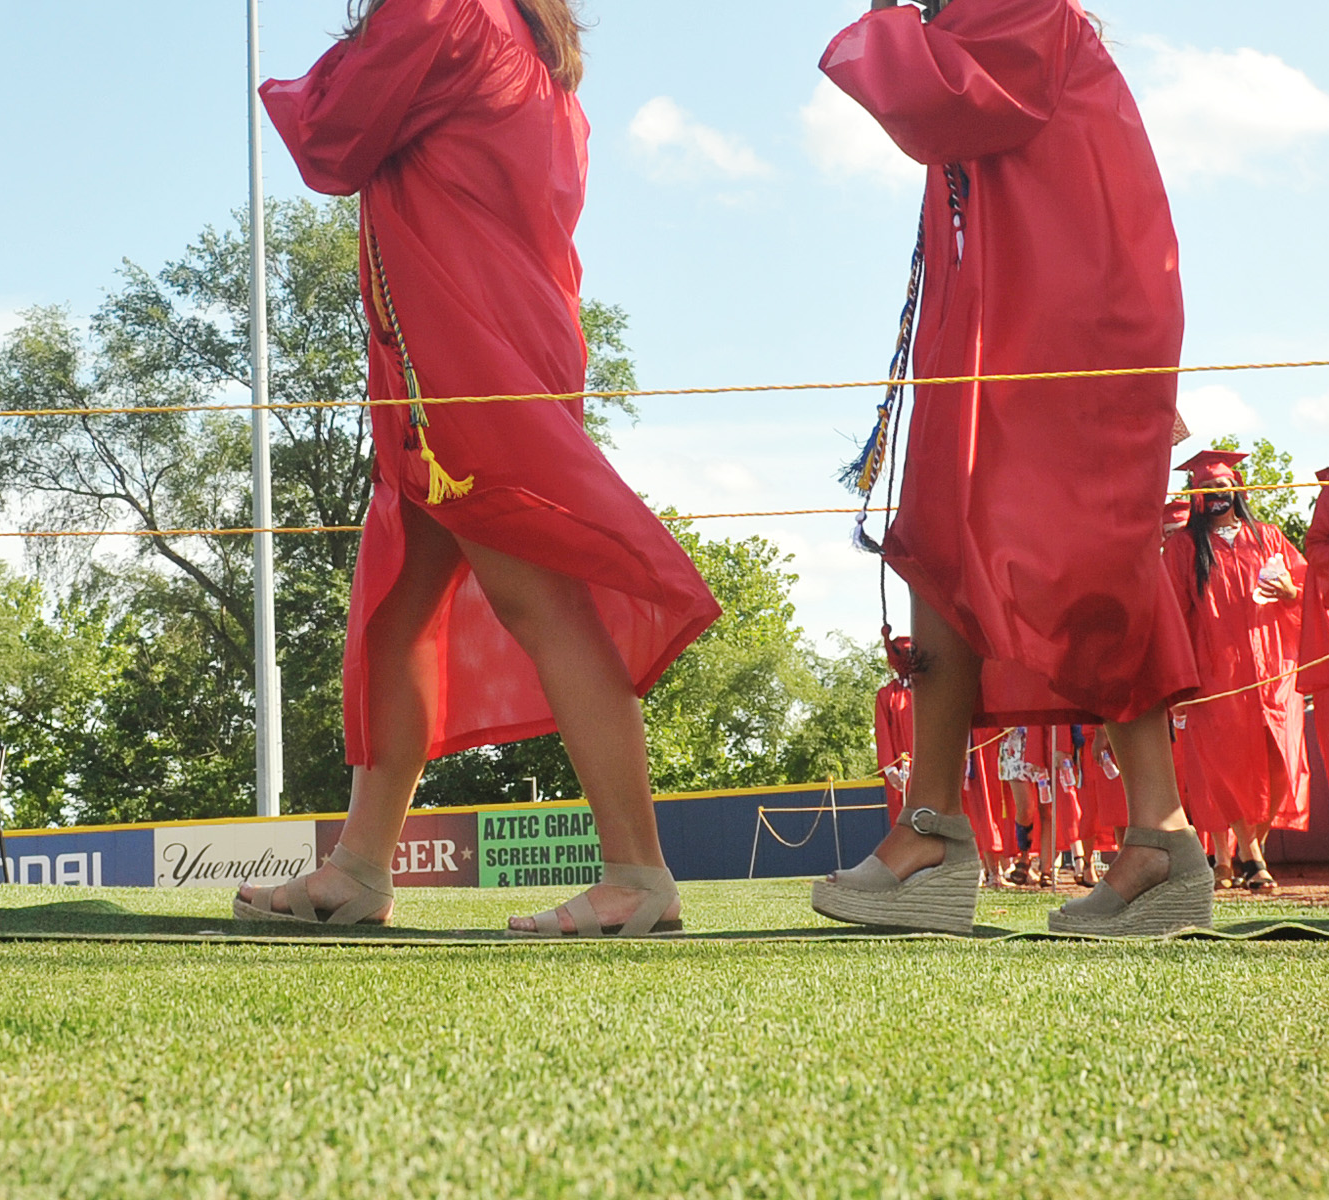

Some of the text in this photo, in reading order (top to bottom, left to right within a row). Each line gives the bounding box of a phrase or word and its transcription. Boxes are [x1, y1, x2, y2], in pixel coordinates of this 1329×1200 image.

[484, 815, 540, 841] AZTEC
[158, 842, 313, 887] Yuengling
[486, 846, 551, 868] SCREEN
[498, 865, 603, 887] & EMBROIDE
